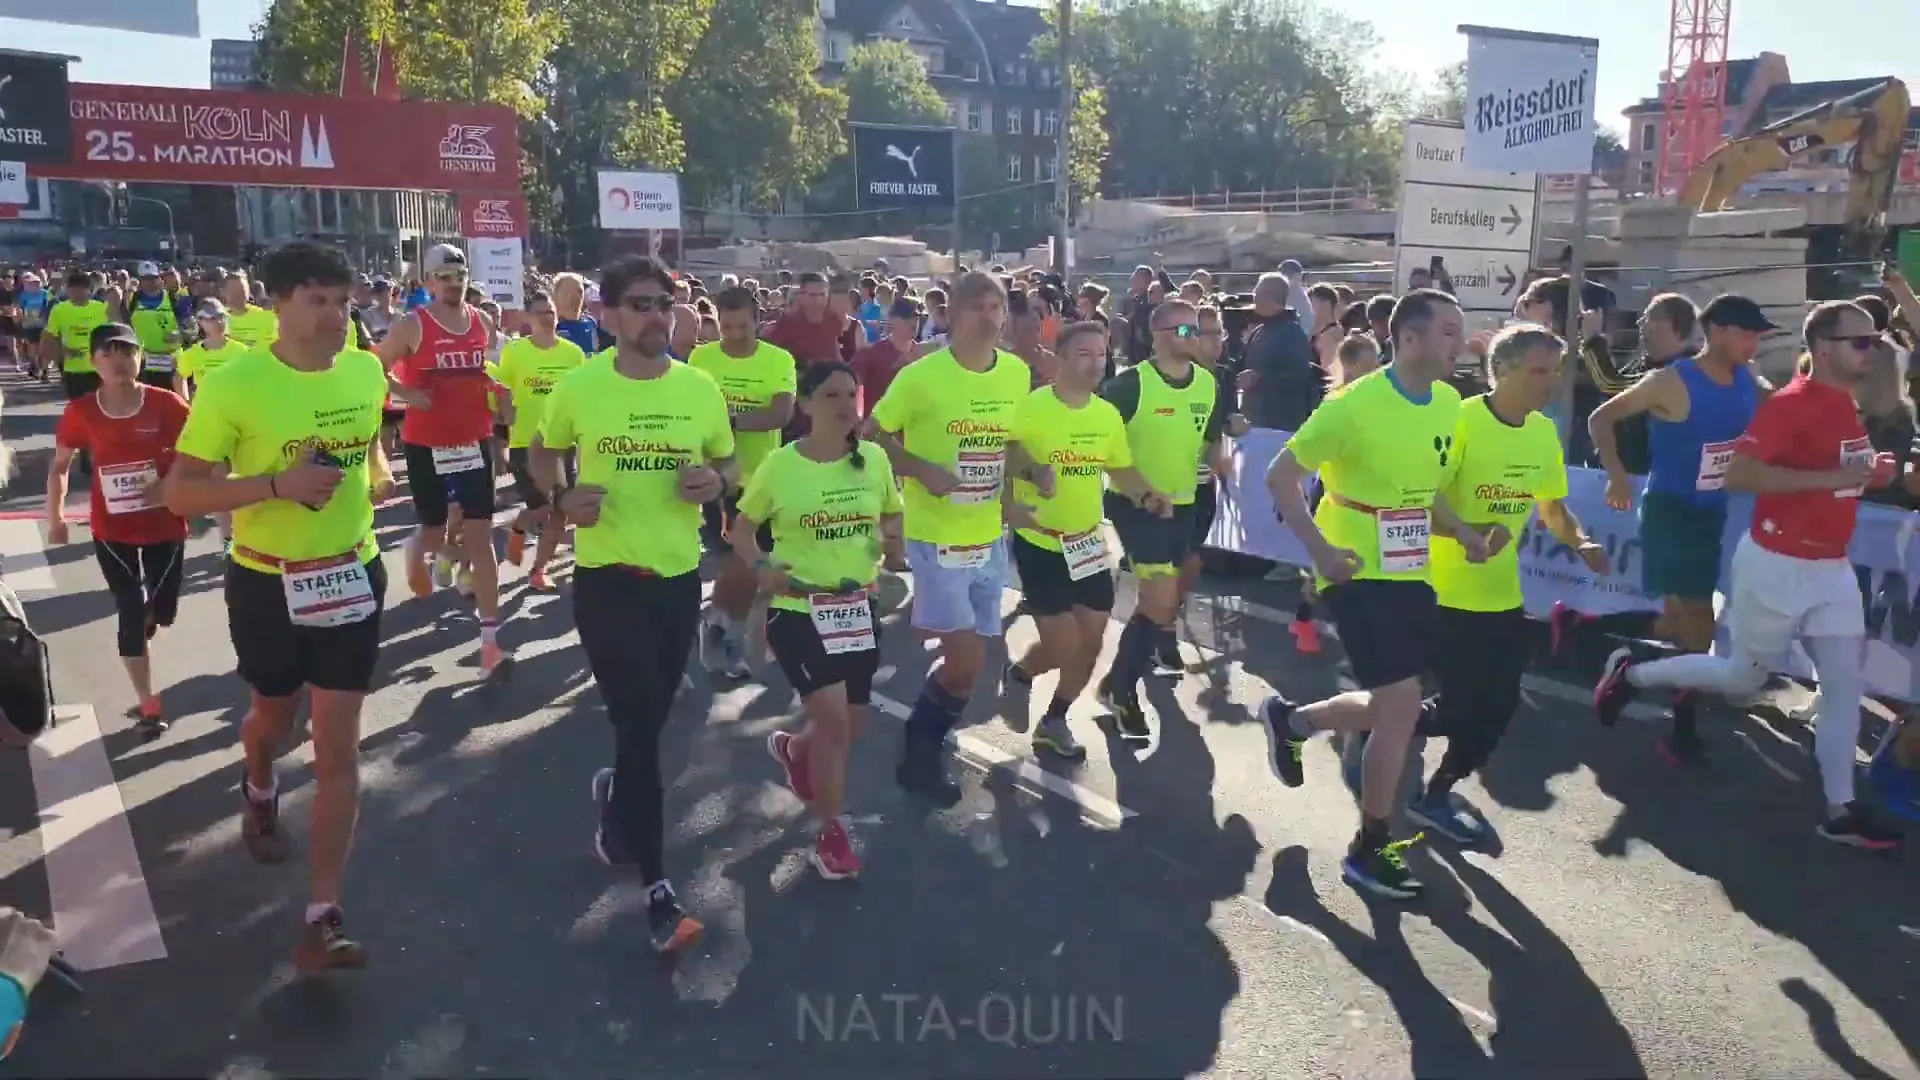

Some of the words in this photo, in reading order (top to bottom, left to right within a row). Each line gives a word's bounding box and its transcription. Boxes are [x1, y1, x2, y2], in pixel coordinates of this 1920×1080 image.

[1474, 69, 1588, 134] Reissdorf
[69, 100, 178, 123] GENERALI
[183, 105, 290, 143] KÖLN
[1504, 110, 1583, 149] ALKOHOLFREI
[85, 129, 147, 162] 25.
[154, 144, 293, 166] MARATHON
[1416, 142, 1455, 162] Deutzer
[1789, 136, 1808, 153] CAT
[439, 159, 496, 173] GENERALI
[633, 190, 662, 201] Rhein
[634, 201, 672, 212] Energie
[474, 222, 515, 232] GENERALI
[1430, 207, 1496, 231] Berufskolleg
[959, 436, 1004, 449] INKLUS
[1066, 536, 1101, 554] STAFFEL
[293, 568, 363, 593] STAFFEL
[818, 606, 868, 621] STAFFEL
